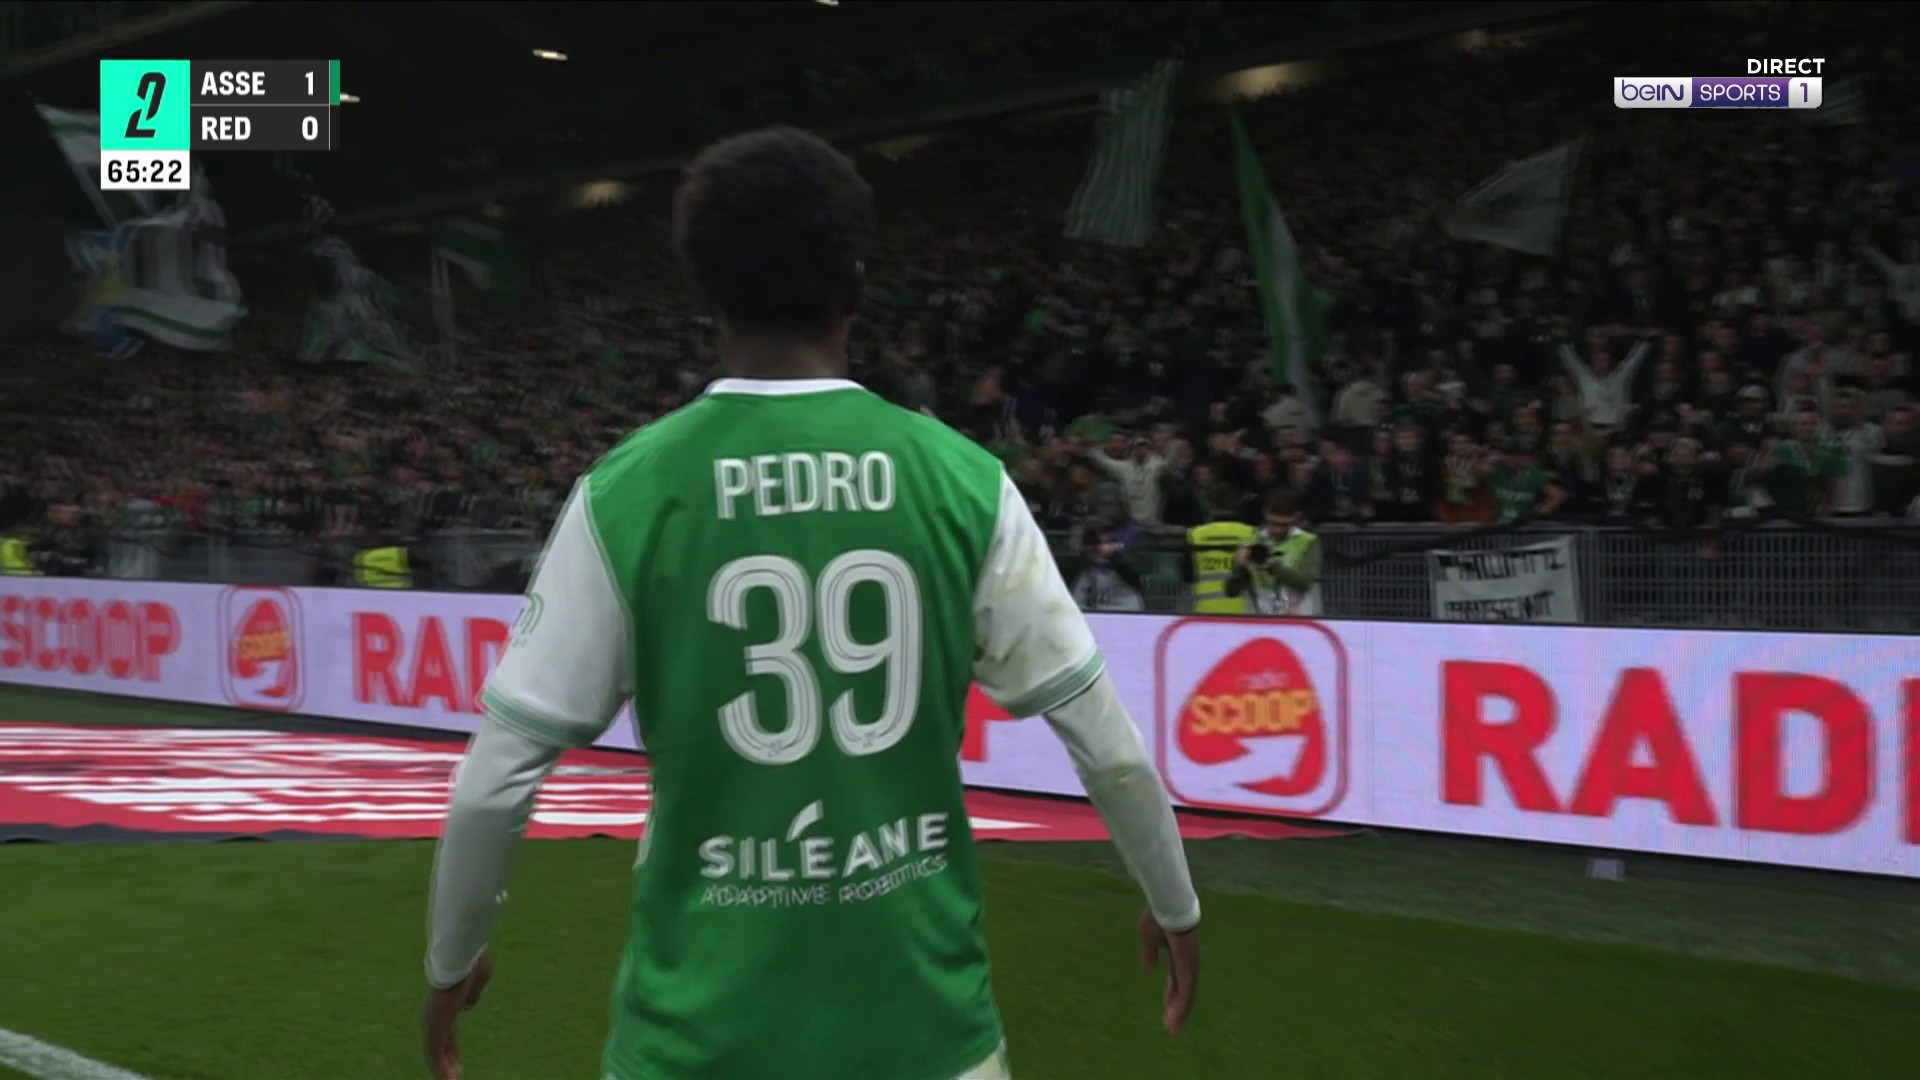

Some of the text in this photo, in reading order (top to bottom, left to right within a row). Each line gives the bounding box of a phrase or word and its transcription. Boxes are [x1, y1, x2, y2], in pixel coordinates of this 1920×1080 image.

[713, 451, 897, 519] PEDRO
[0, 594, 181, 682] SCOOP
[706, 549, 923, 765] 39
